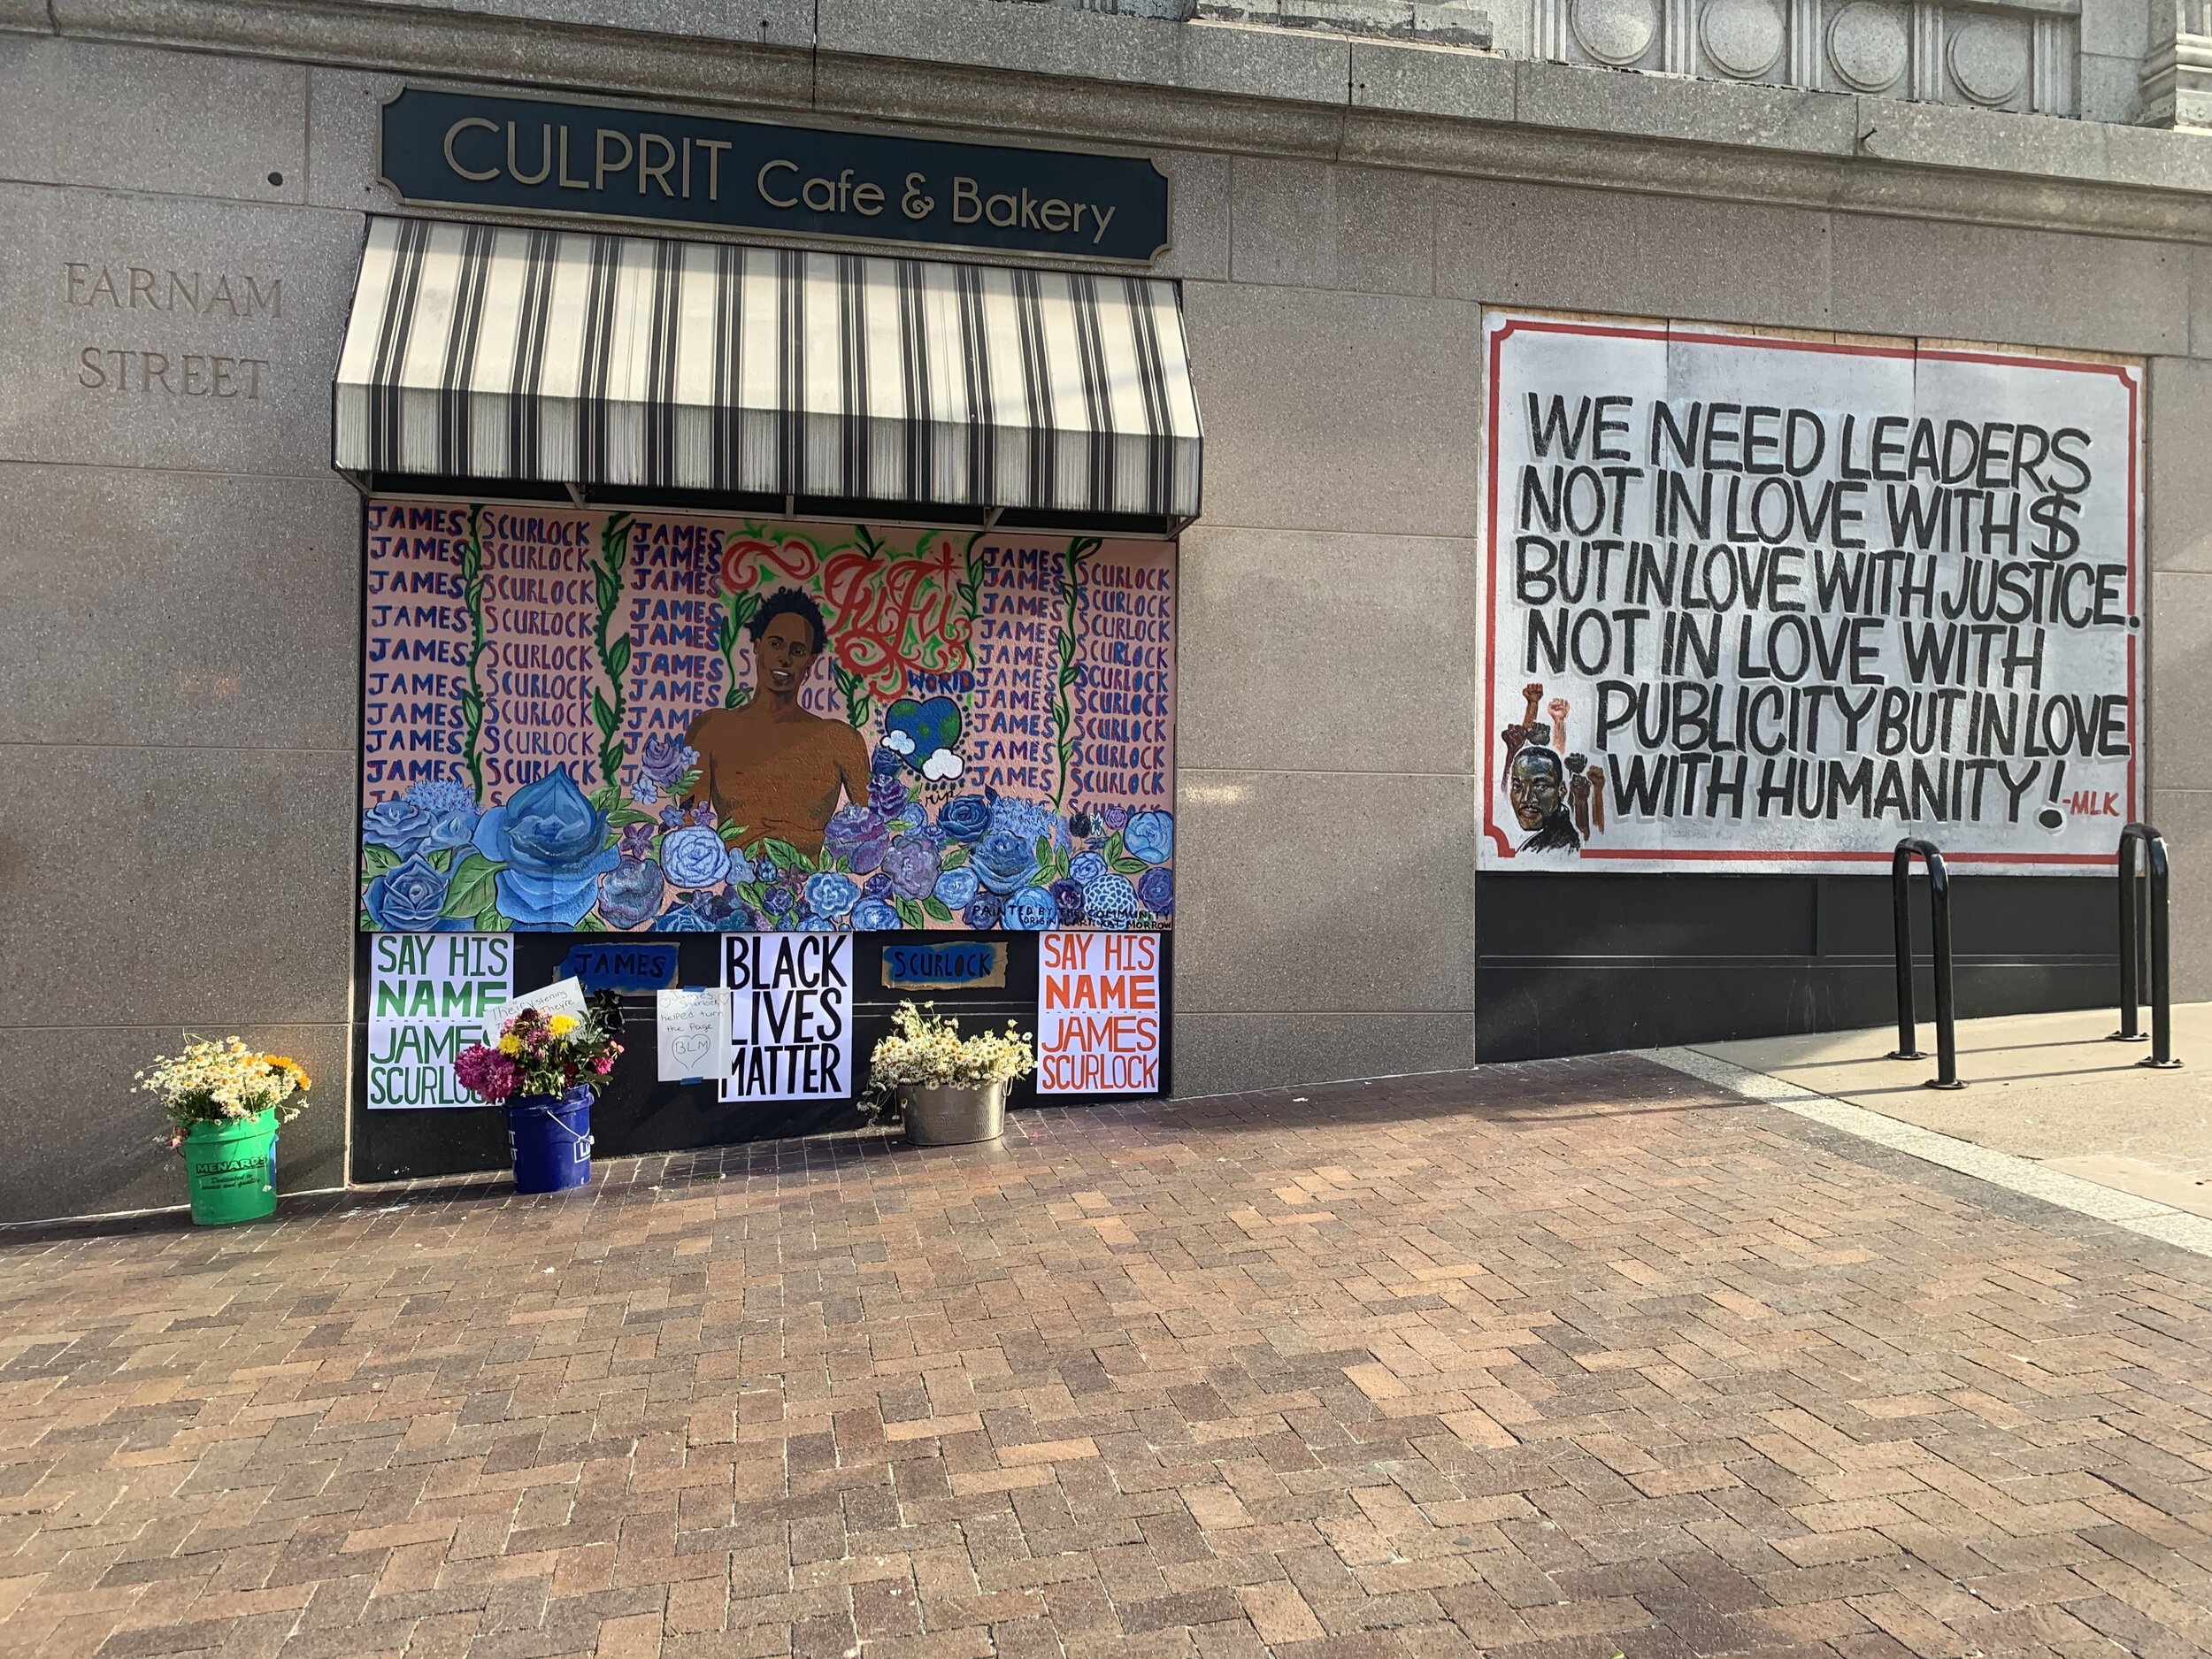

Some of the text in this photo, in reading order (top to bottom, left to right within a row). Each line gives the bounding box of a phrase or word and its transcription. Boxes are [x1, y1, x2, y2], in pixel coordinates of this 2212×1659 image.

[443, 117, 1117, 244] CULPRIT Cafe & Bakery
[63, 262, 282, 319] FARNAM
[78, 346, 270, 399] STREET
[1528, 392, 2093, 495] WE NEED LEADERS
[368, 506, 590, 546] JAMES SCURLOCK
[1520, 465, 2082, 564] NOT IN LOVE WITH $
[370, 536, 591, 572] JAMES SCURLOCK
[634, 523, 725, 554] JAMES
[630, 544, 723, 574] JAMES
[984, 547, 1170, 591] JAMES SCURLOCK
[369, 570, 595, 605] JAMES SCURLOCK
[631, 569, 723, 599] JAMES
[984, 568, 1171, 618] JAMES SCURLOCK
[1516, 535, 2141, 629] BUT IN LOVE WITH JUSTICE.
[372, 605, 594, 639] JAMES SCURLOCK
[630, 599, 723, 627] JAMES
[982, 593, 1171, 642] JAMES SCURLOCK
[370, 638, 594, 672] JAMES SCURLOCK
[630, 624, 722, 652] JAMES
[980, 619, 1169, 669] JAMES SCURLOCK
[1525, 608, 2047, 689] NOT IN LOVE WITH
[368, 669, 594, 701] JAMES SCURLOCK
[632, 652, 724, 682] JAMES
[979, 644, 1168, 693] JAMES SCURLOCK
[629, 679, 721, 707] JAMES
[977, 668, 1168, 717] JAMES SCURLOCK
[367, 697, 594, 728] JAMES SCURLOCK
[627, 706, 703, 731] JAM
[974, 689, 1166, 743] JAMES SCURLOCK
[1595, 680, 2131, 758] PUBLICITY BUT IN LOVE
[366, 726, 595, 755] JAMES SCURLOCK
[974, 711, 1165, 770] JAMES SCURLOCK
[366, 759, 465, 784] JAMES
[487, 758, 596, 786] SCURCK
[972, 766, 1054, 792] JAMES
[973, 741, 1164, 796] JAMES SCURLOCK
[1607, 752, 2067, 830] WITH HUMANITY!
[377, 935, 509, 977] SAY HIS
[573, 953, 666, 979] JAMES
[726, 934, 849, 990] BLACK
[894, 950, 992, 979] SCURLOCK
[1044, 933, 1156, 972] SAY HIS
[376, 979, 508, 1018] NAME
[1045, 974, 1156, 1010] NAME
[731, 987, 842, 1046] LIVES
[1041, 1015, 1158, 1053] JAMES
[370, 1025, 491, 1064] JAME
[675, 1040, 709, 1055] BLM
[721, 1043, 842, 1099] MATTER
[1042, 1054, 1158, 1090] SCURLOCK
